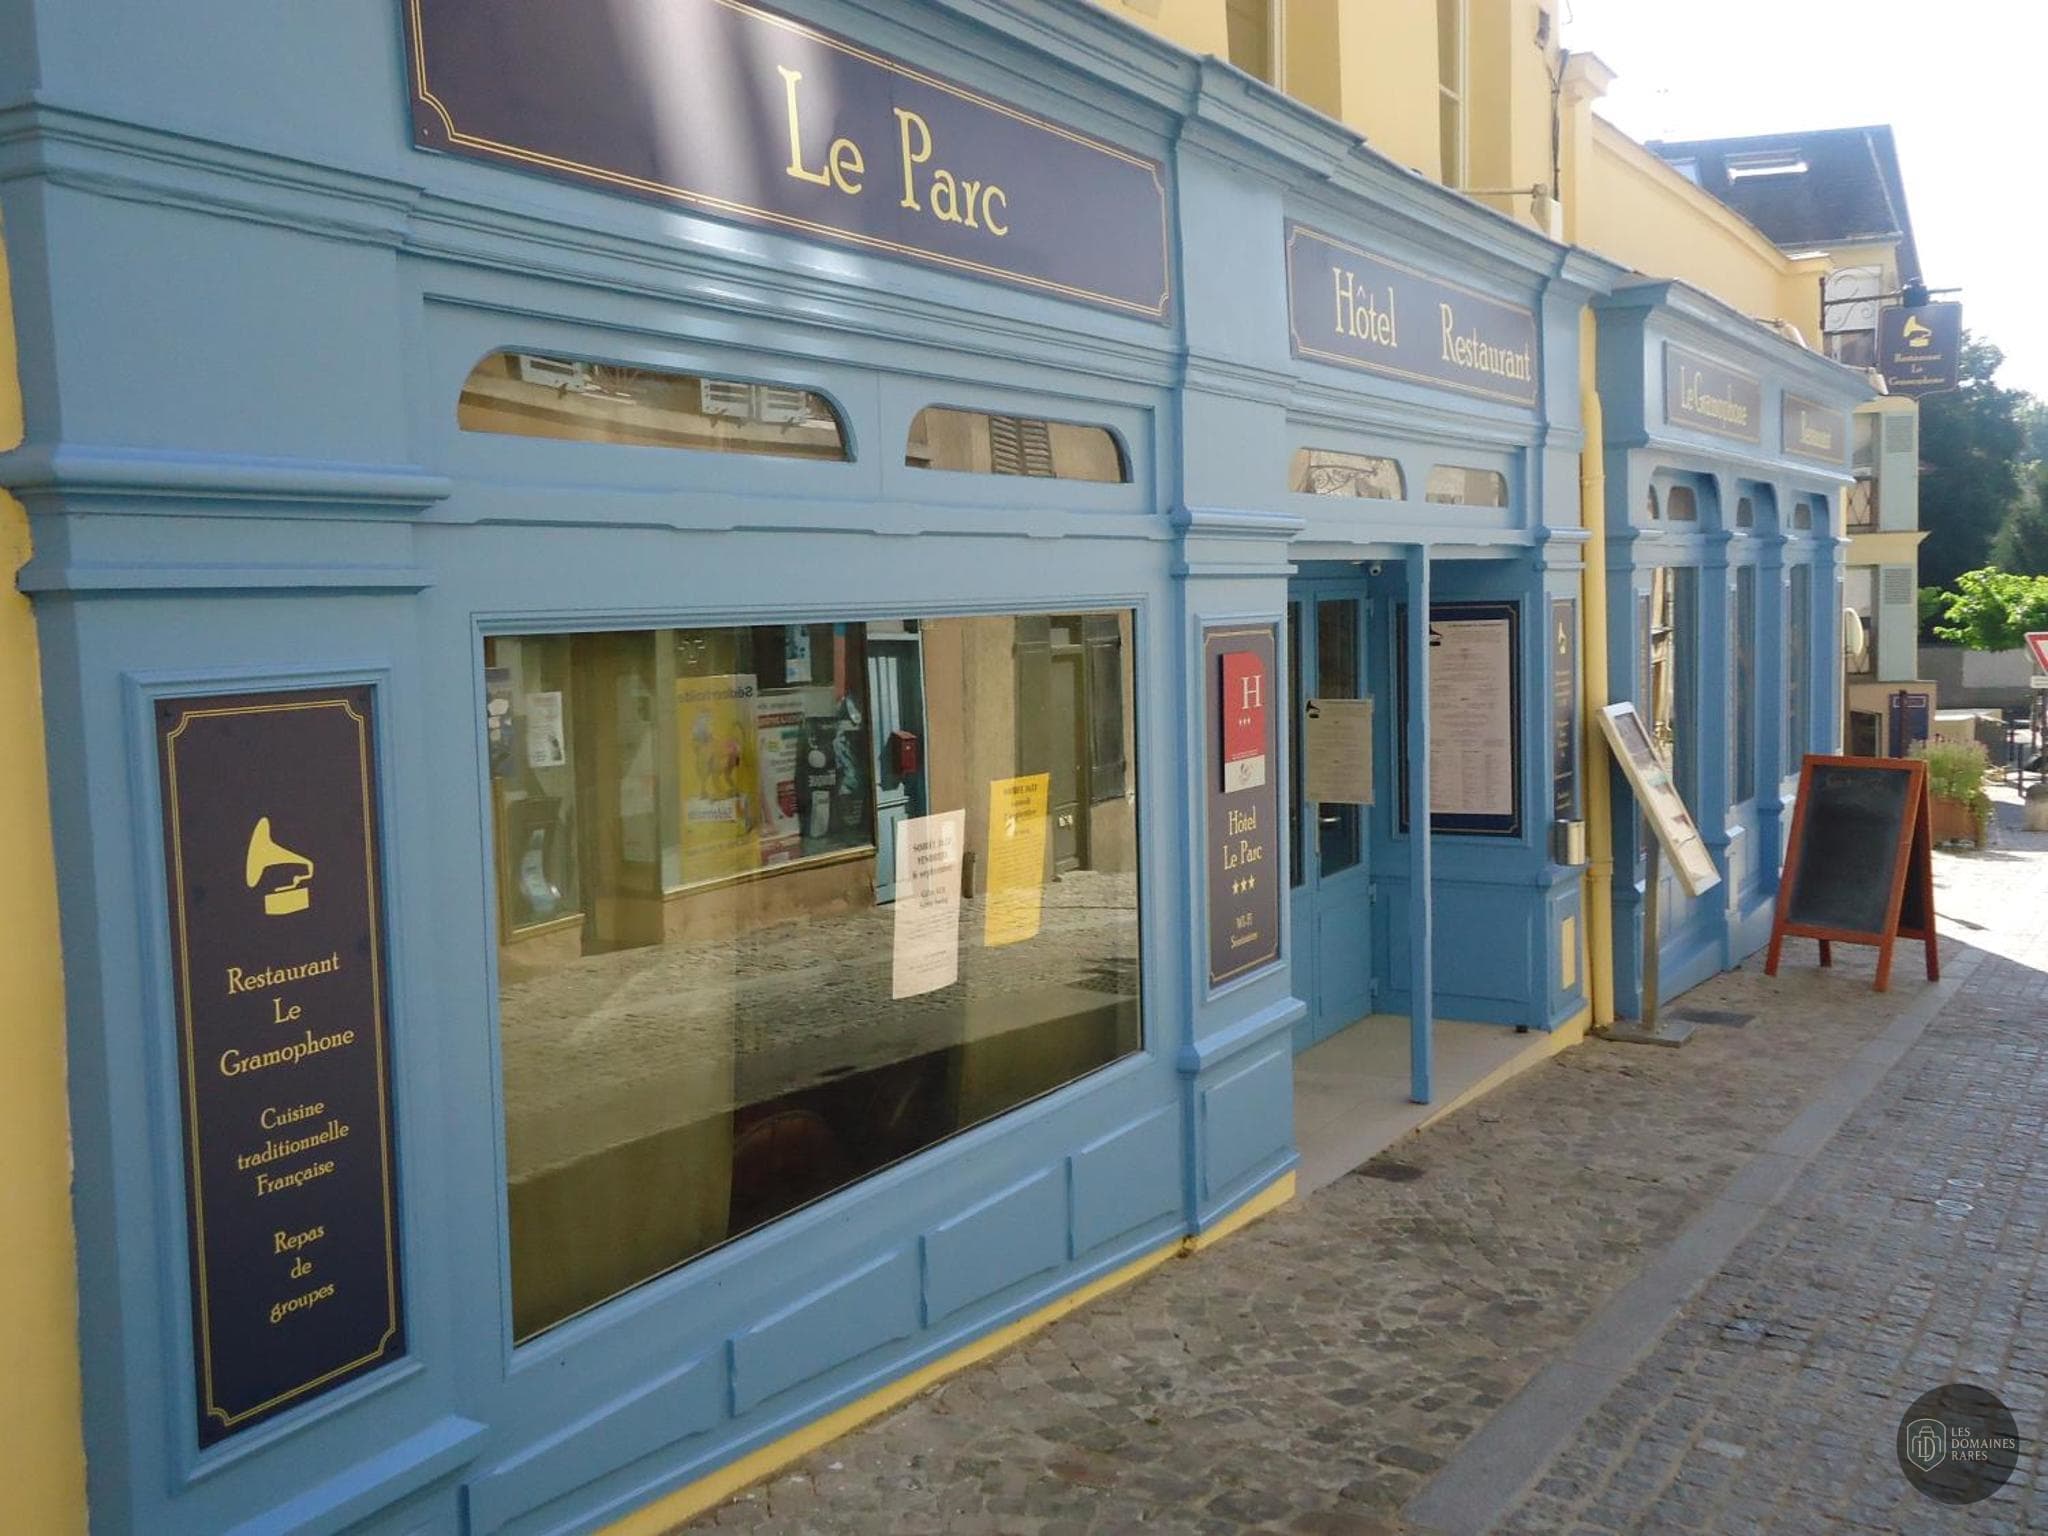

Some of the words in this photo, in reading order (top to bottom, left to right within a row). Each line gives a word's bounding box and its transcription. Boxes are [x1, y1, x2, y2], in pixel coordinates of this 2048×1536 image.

[777, 64, 865, 195] Le
[893, 106, 1009, 237] Parc
[1332, 266, 1398, 348] Hôtel
[1439, 302, 1532, 383] Restaurant
[1241, 674, 1263, 710] H
[1228, 804, 1257, 836] Hôtel
[1222, 845, 1238, 871] Le
[1240, 839, 1263, 865] Parc
[226, 951, 341, 995] Restaurant
[272, 997, 303, 1025] Le
[219, 1029, 356, 1077] Gramophone
[260, 1100, 326, 1130] Cuisine
[236, 1119, 350, 1171] traditionnelle
[255, 1159, 335, 1197] Française
[273, 1224, 326, 1255] Repas
[289, 1256, 313, 1280] de
[269, 1282, 336, 1325] groupes
